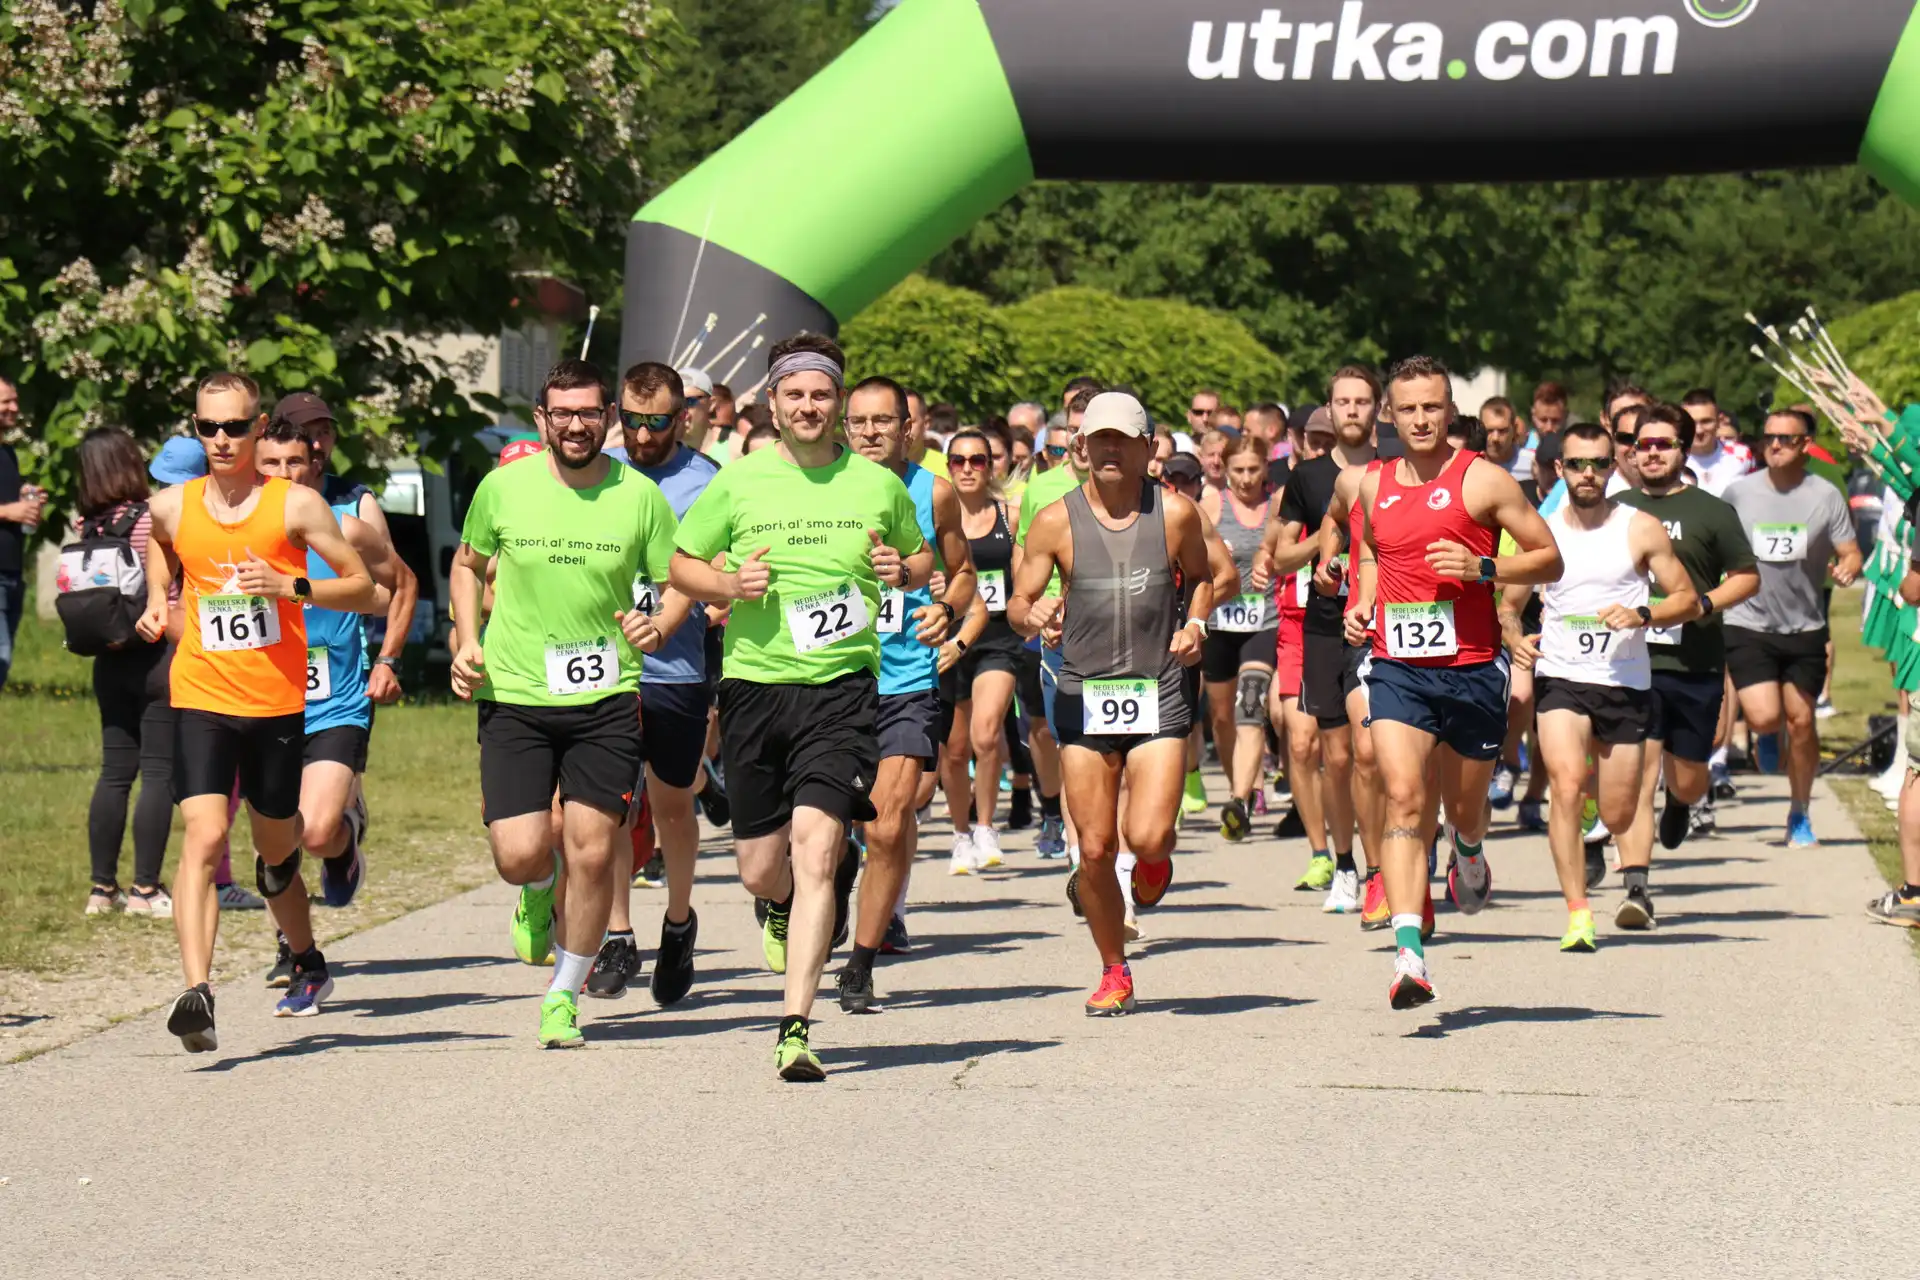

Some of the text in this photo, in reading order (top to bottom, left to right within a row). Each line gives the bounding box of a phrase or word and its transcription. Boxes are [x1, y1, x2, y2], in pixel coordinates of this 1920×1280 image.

[1187, 0, 1680, 82] utrka.com
[751, 520, 786, 534] spori,
[806, 520, 833, 529] smo
[836, 520, 864, 530] zato
[515, 538, 548, 548] spori,
[568, 540, 593, 550] smo
[596, 542, 621, 553] zato
[787, 534, 828, 546] debeli
[1766, 537, 1793, 555] 73
[548, 554, 586, 566] debeli
[207, 599, 247, 607] NEDELSKA
[794, 590, 835, 607] NEDELSKA
[978, 585, 998, 604] 2
[809, 603, 853, 639] 22
[1223, 607, 1259, 625] 106
[210, 611, 267, 641] 161
[1392, 620, 1447, 648] 132
[555, 640, 594, 651] NEDELSKA
[1578, 632, 1611, 654] 97
[566, 654, 605, 684] 63
[1102, 698, 1139, 725] 99
